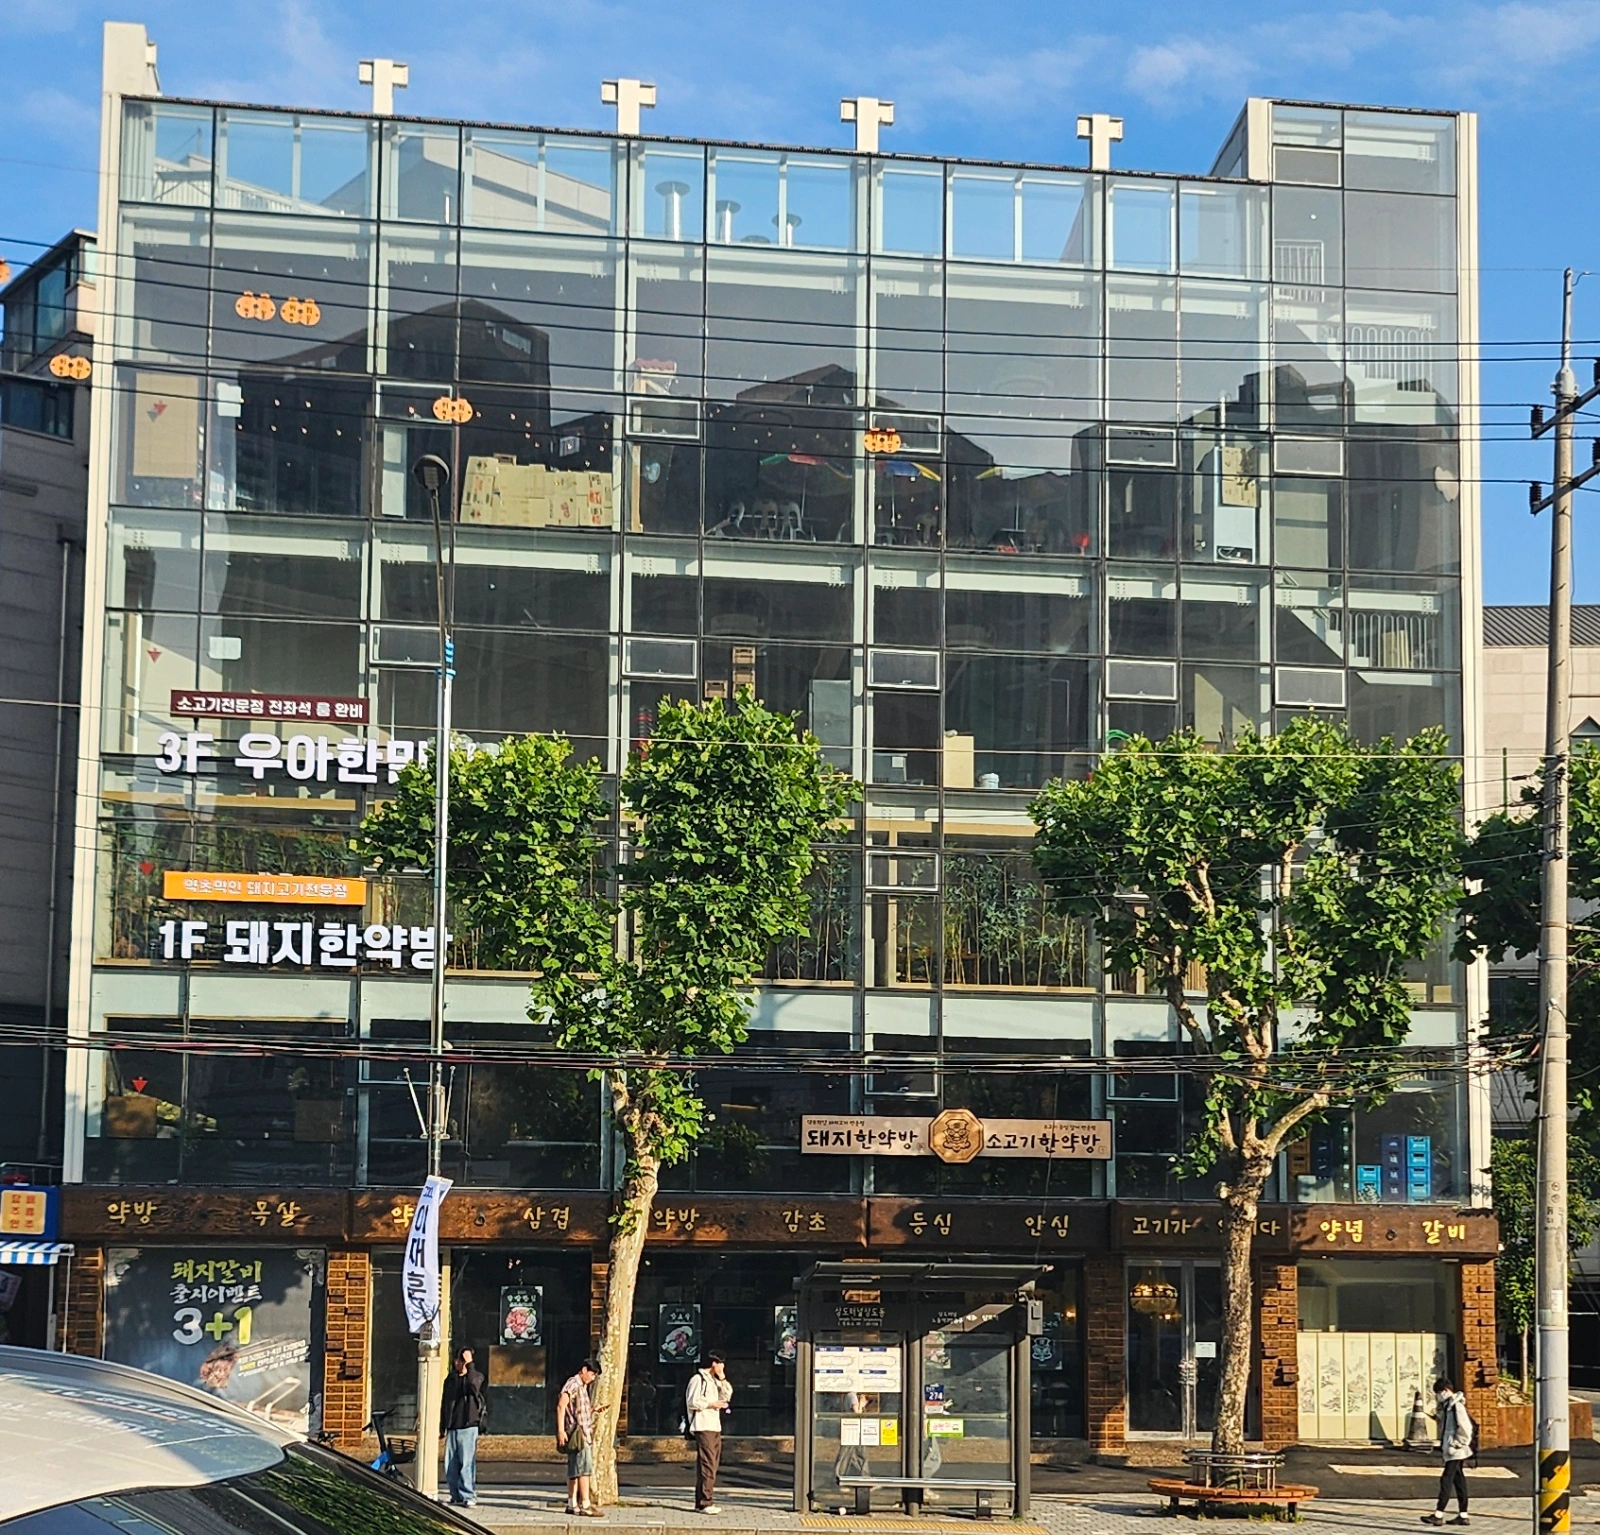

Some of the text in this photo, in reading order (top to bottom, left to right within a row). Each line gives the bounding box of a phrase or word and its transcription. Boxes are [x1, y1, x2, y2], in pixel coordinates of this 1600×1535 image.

[177, 696, 264, 715] 소고기전문점
[269, 699, 311, 716] 전좌석
[334, 702, 363, 718] 완비
[155, 732, 214, 773] 3F
[184, 879, 348, 898] 약초먹인 돼지고기전문점
[159, 920, 453, 970] 1F 돼지한약방
[806, 1128, 919, 1150] 돼지한약방
[986, 1132, 1101, 1154] 소고기한약방
[107, 1201, 301, 1227] 약방 목살
[523, 1206, 570, 1230] 삼겹
[653, 1207, 827, 1233] 약방 감초
[909, 1212, 1069, 1237] 등심 안심
[1132, 1217, 1192, 1235] 고기가
[1320, 1219, 1466, 1245] 양념 갈비
[170, 1258, 263, 1284] 돼지갈비
[169, 1283, 263, 1305] 출시이벤트
[172, 1306, 253, 1346] 3+1
[929, 1391, 943, 1400] 274
